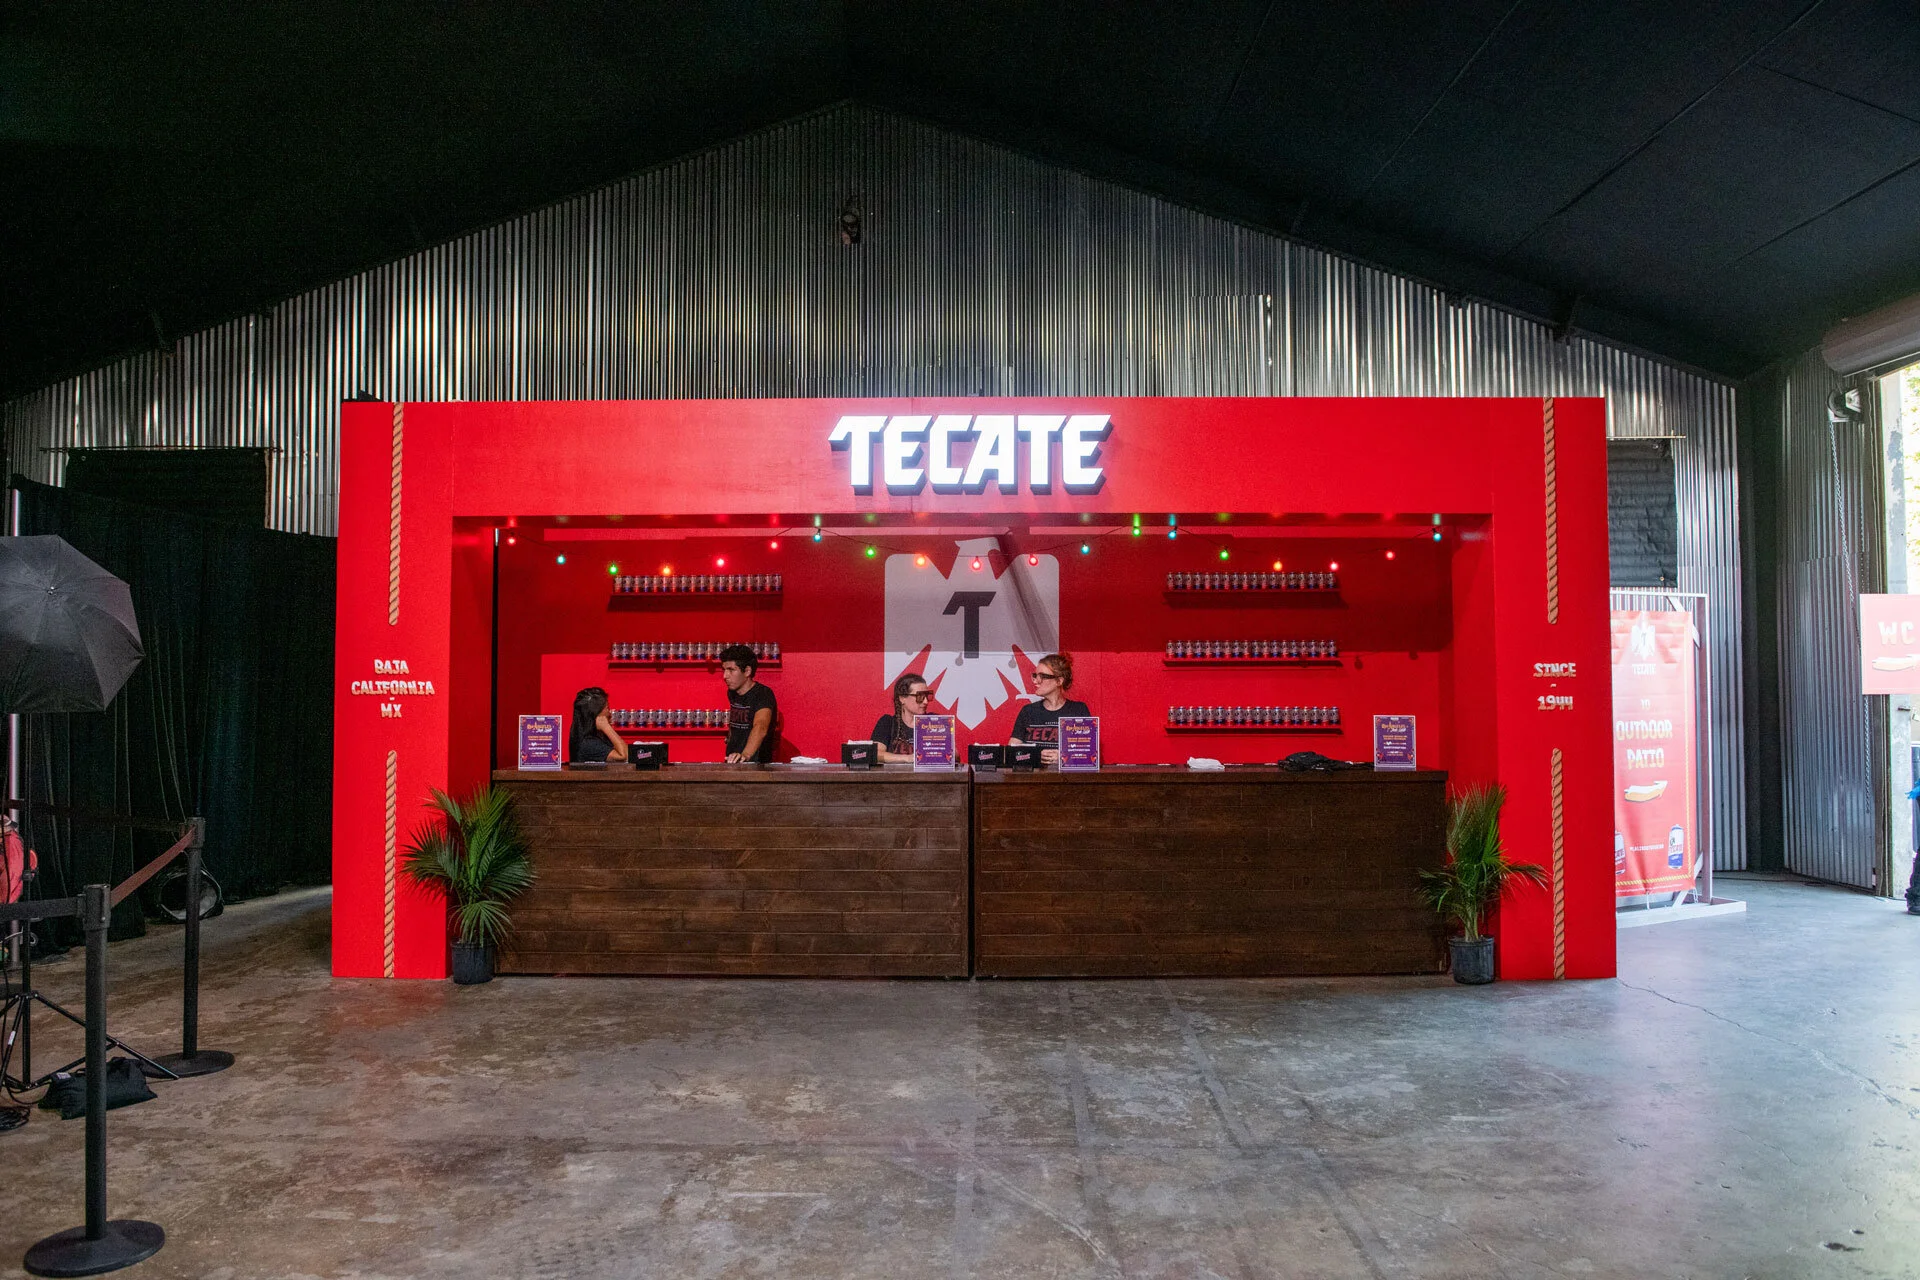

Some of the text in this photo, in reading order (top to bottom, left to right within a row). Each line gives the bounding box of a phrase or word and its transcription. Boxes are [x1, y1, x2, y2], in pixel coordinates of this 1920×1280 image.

[828, 414, 1113, 494] TECATE
[942, 591, 997, 659] T
[1878, 621, 1916, 645] WC
[374, 659, 410, 675] BAJA
[1533, 662, 1577, 677] SINCE
[351, 680, 435, 695] CALIFORNIA
[380, 703, 402, 718] MX
[1537, 695, 1573, 711] 1944
[1026, 727, 1059, 741] TECA
[1615, 720, 1673, 741] OUTDOOR
[1627, 748, 1664, 769] PATIO
